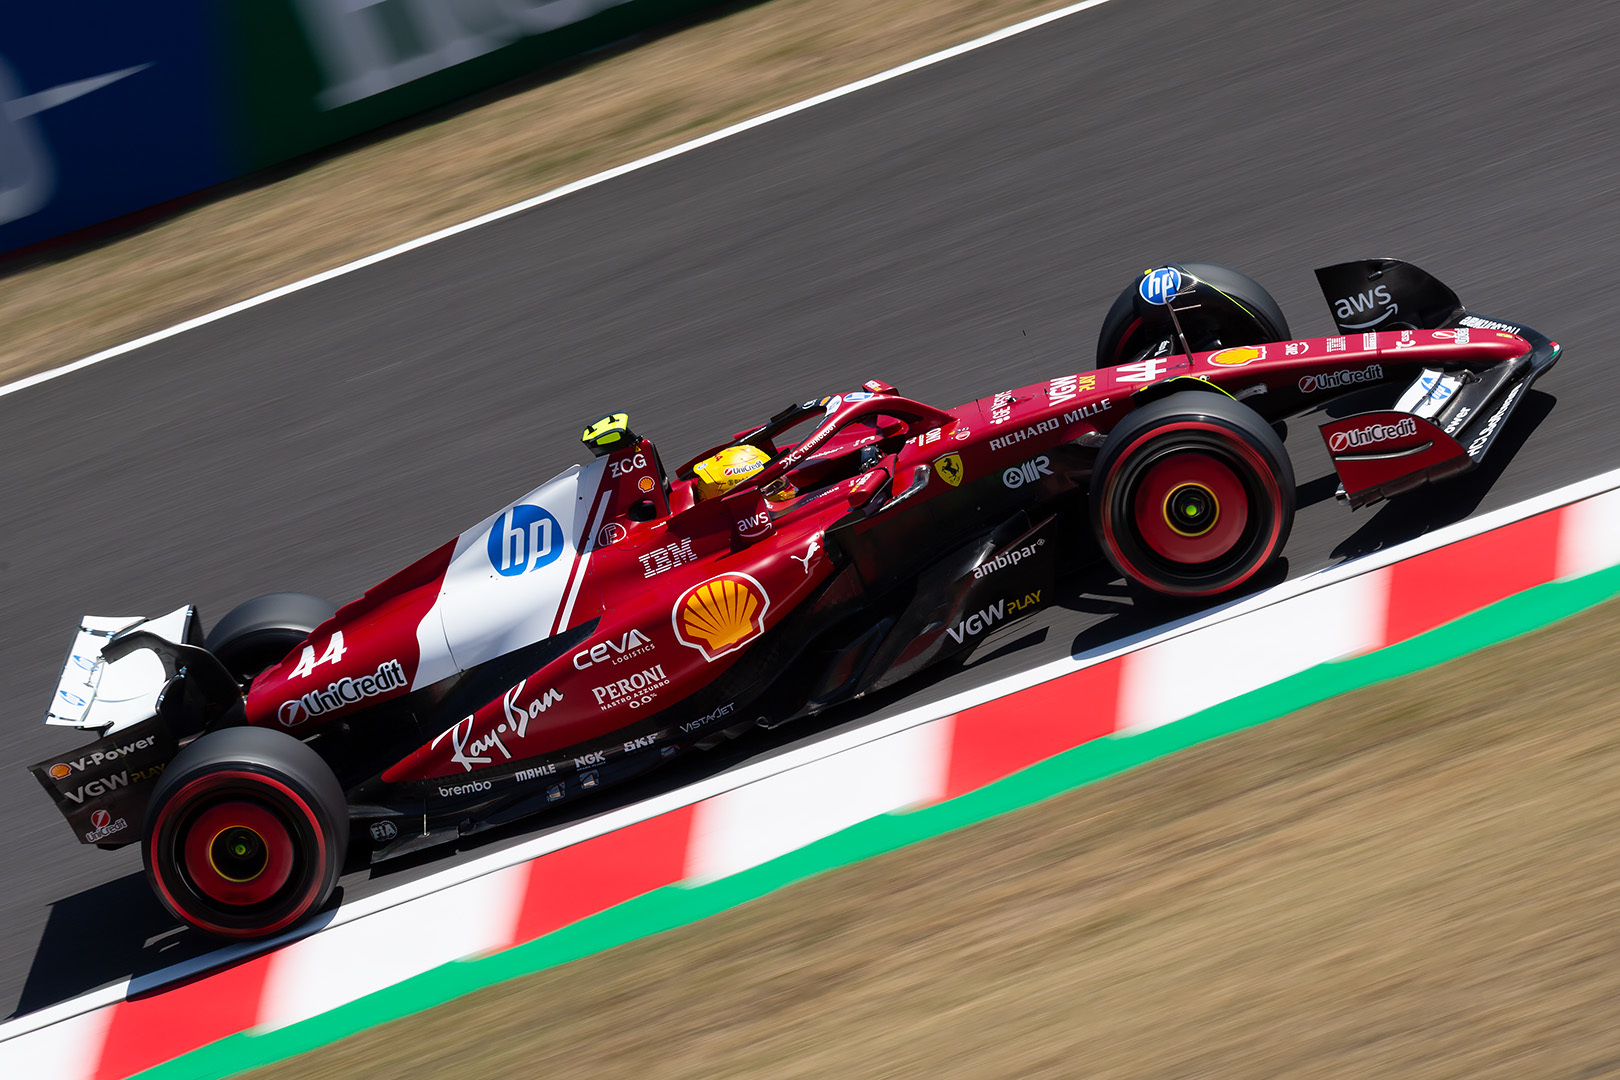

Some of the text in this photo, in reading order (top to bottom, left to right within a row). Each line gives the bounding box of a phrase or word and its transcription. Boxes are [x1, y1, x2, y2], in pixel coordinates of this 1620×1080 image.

[1147, 269, 1176, 304] hp
[1335, 284, 1391, 319] aws
[1078, 375, 1095, 392] PLAY
[1115, 358, 1167, 383] 44
[1315, 364, 1384, 390] UniCredit
[1049, 375, 1077, 407] VGW
[989, 398, 1113, 451] RICHARD MILLE
[1347, 417, 1417, 447] UniCredit
[1444, 406, 1472, 434] ower
[609, 453, 647, 478] ZCG
[732, 460, 764, 475] UniCredit
[737, 511, 769, 532] aws
[498, 505, 556, 575] hp
[638, 537, 698, 579] IBM
[946, 590, 1042, 645] VGW PLAY
[287, 630, 347, 680] 44
[612, 643, 656, 666] LOGISTICS
[302, 659, 408, 717] UniCredit
[591, 664, 667, 705] PERONI
[601, 679, 670, 711] NASTRO AZZURRO
[70, 734, 156, 772] V-Power
[624, 733, 659, 753] SKF
[514, 763, 557, 783] MAHLE
[574, 750, 606, 769] NGK
[64, 763, 166, 805] VGW PLAY
[439, 780, 492, 797] brembo
[86, 817, 127, 843] UniCredit
